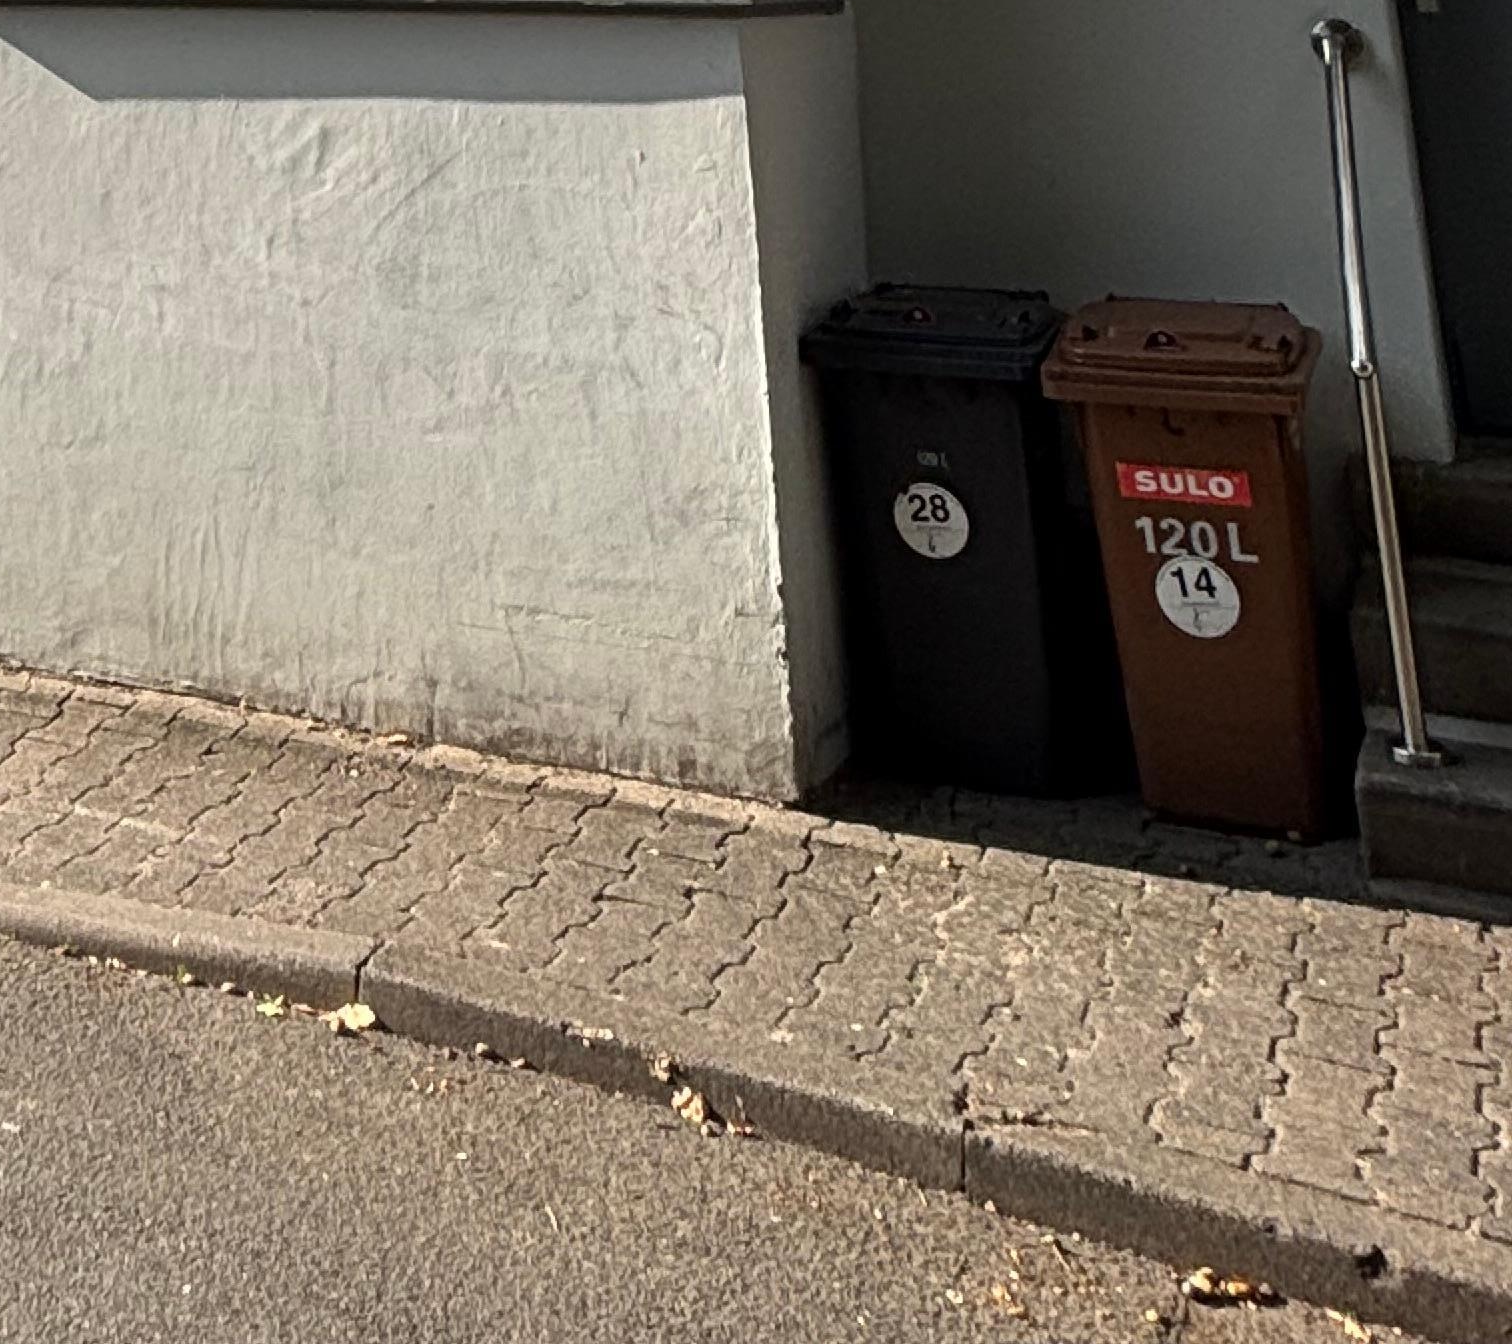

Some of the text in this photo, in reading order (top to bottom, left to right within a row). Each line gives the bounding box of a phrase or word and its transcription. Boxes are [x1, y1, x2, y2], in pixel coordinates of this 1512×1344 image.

[1134, 470, 1235, 499] SULO
[908, 495, 950, 523] 28
[1135, 516, 1260, 563] 120 L
[1171, 567, 1216, 599] 14
